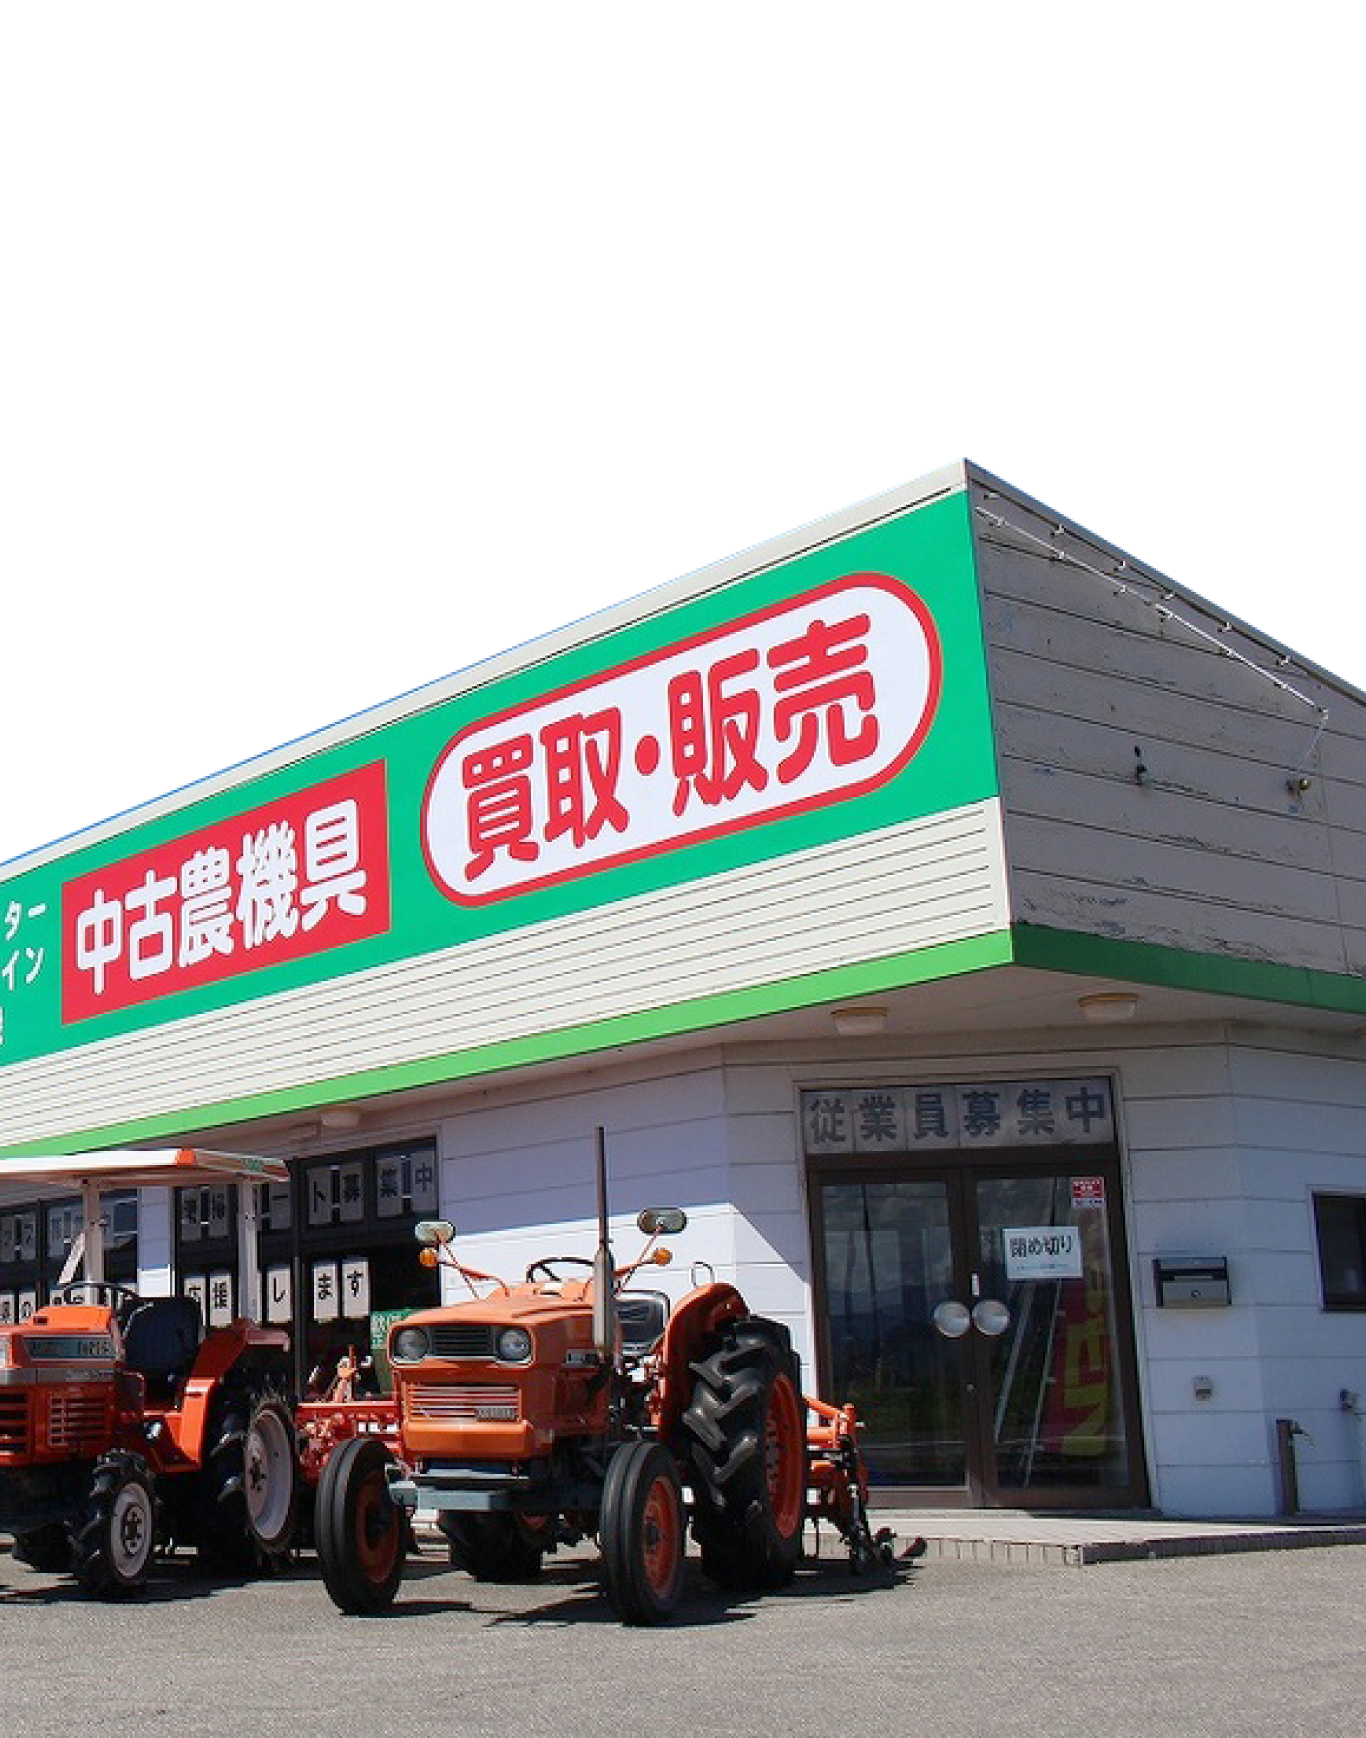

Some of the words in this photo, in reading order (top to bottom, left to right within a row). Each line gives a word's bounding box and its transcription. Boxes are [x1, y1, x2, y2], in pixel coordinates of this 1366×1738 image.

[461, 612, 883, 882] 買取・販売
[74, 798, 369, 996] 中古農機具
[809, 1086, 1107, 1145] 従業員募集中
